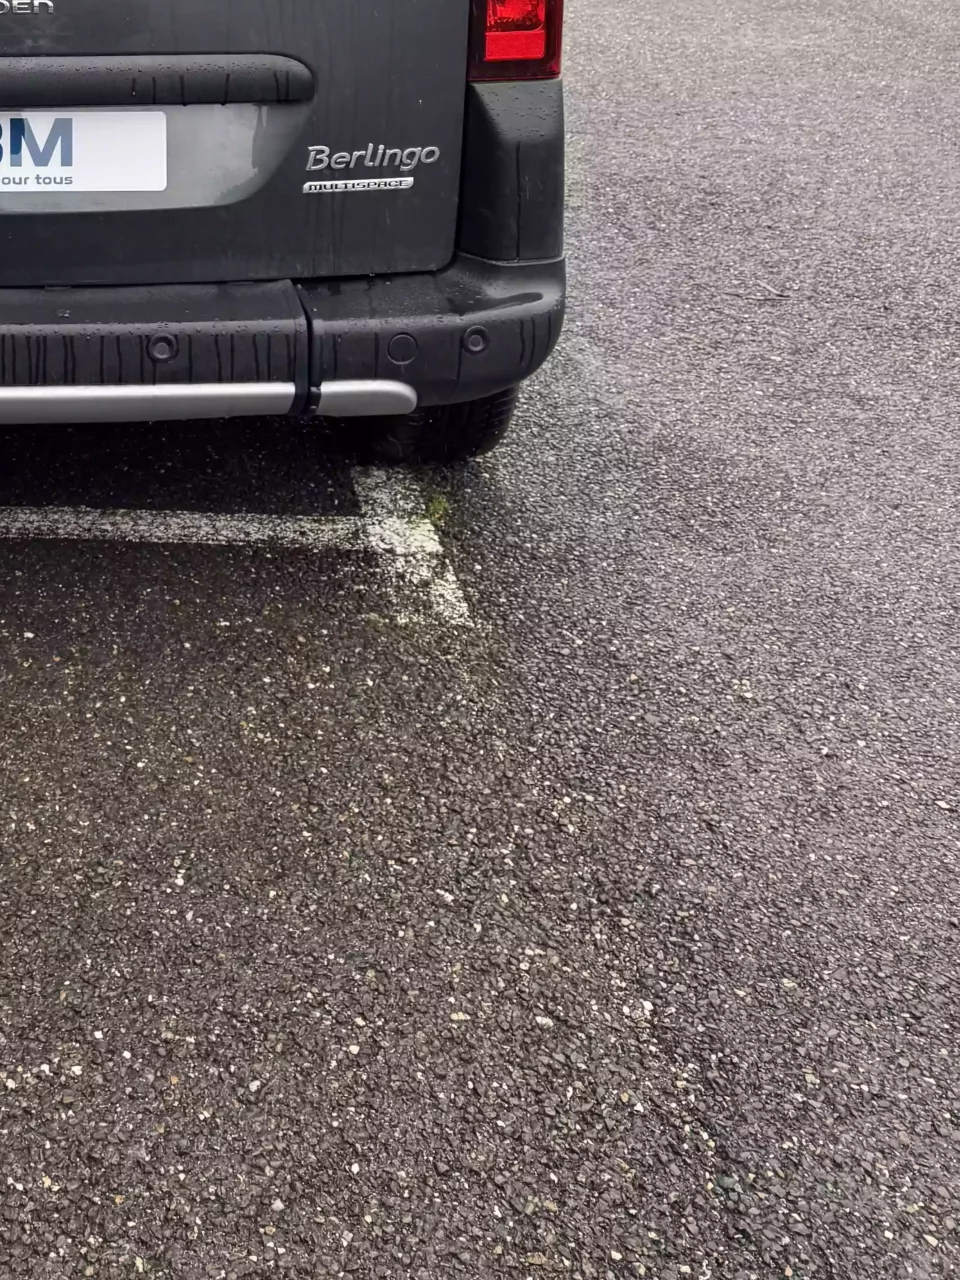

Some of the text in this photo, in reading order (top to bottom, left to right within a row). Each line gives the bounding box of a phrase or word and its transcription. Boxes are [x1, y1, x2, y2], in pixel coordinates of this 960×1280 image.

[305, 143, 441, 171] Berlingo
[35, 174, 74, 185] tous
[308, 179, 409, 193] MULTISPACE
